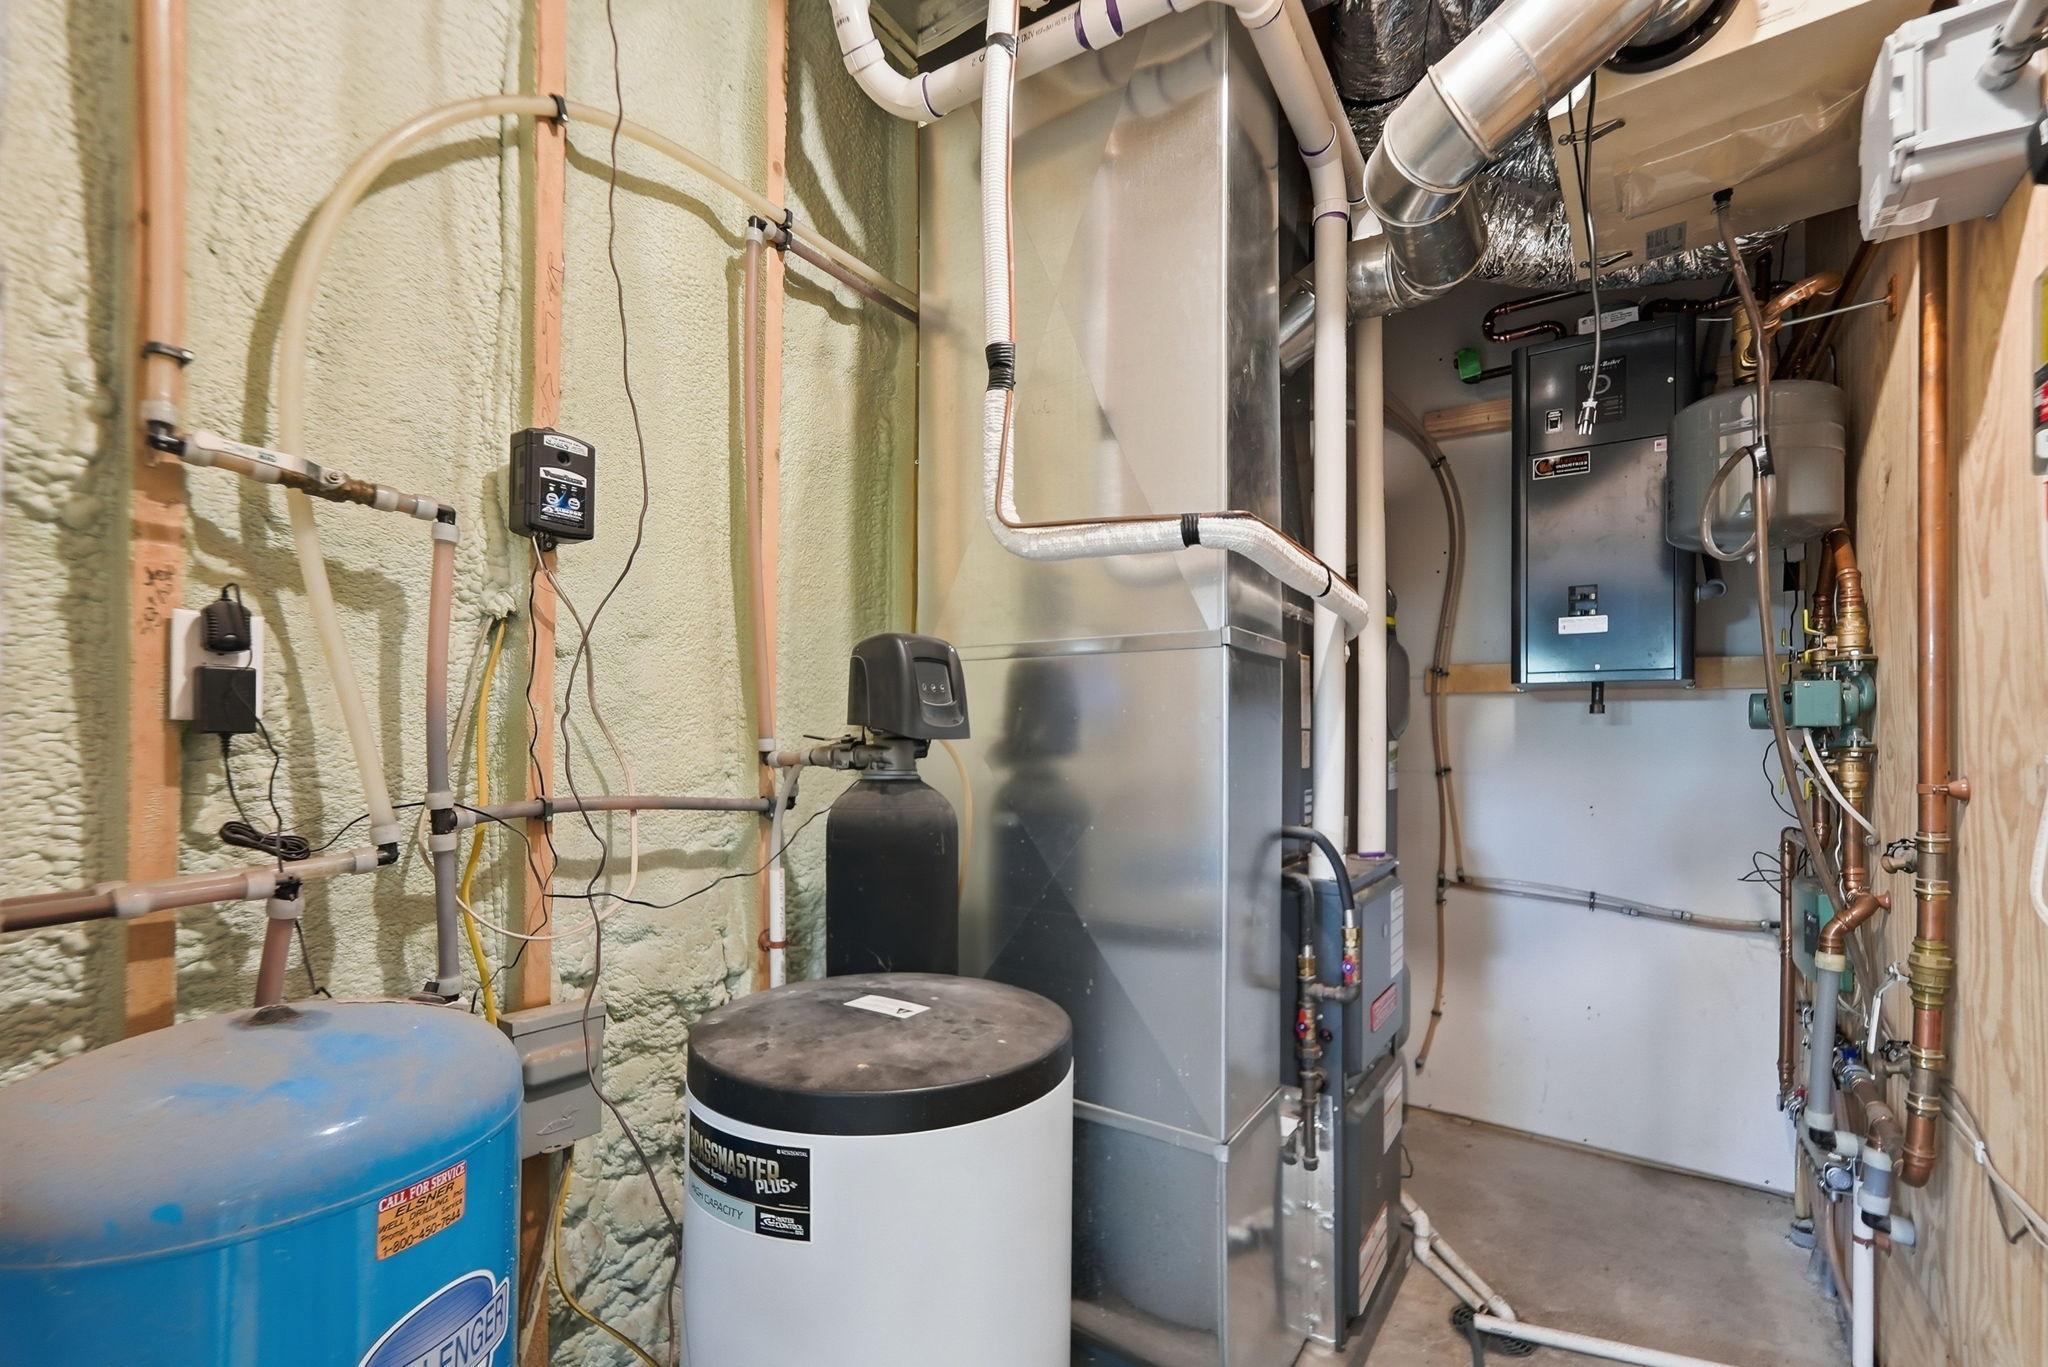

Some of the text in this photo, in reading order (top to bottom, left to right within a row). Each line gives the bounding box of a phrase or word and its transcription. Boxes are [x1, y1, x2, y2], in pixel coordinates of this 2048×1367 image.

[379, 1163, 466, 1213] CALL FOR SERVICE
[395, 1182, 455, 1218] ELSNER
[409, 1196, 449, 1221] DRILLING
[704, 1193, 743, 1220] CAPACITY
[423, 1294, 504, 1367] ENGER
